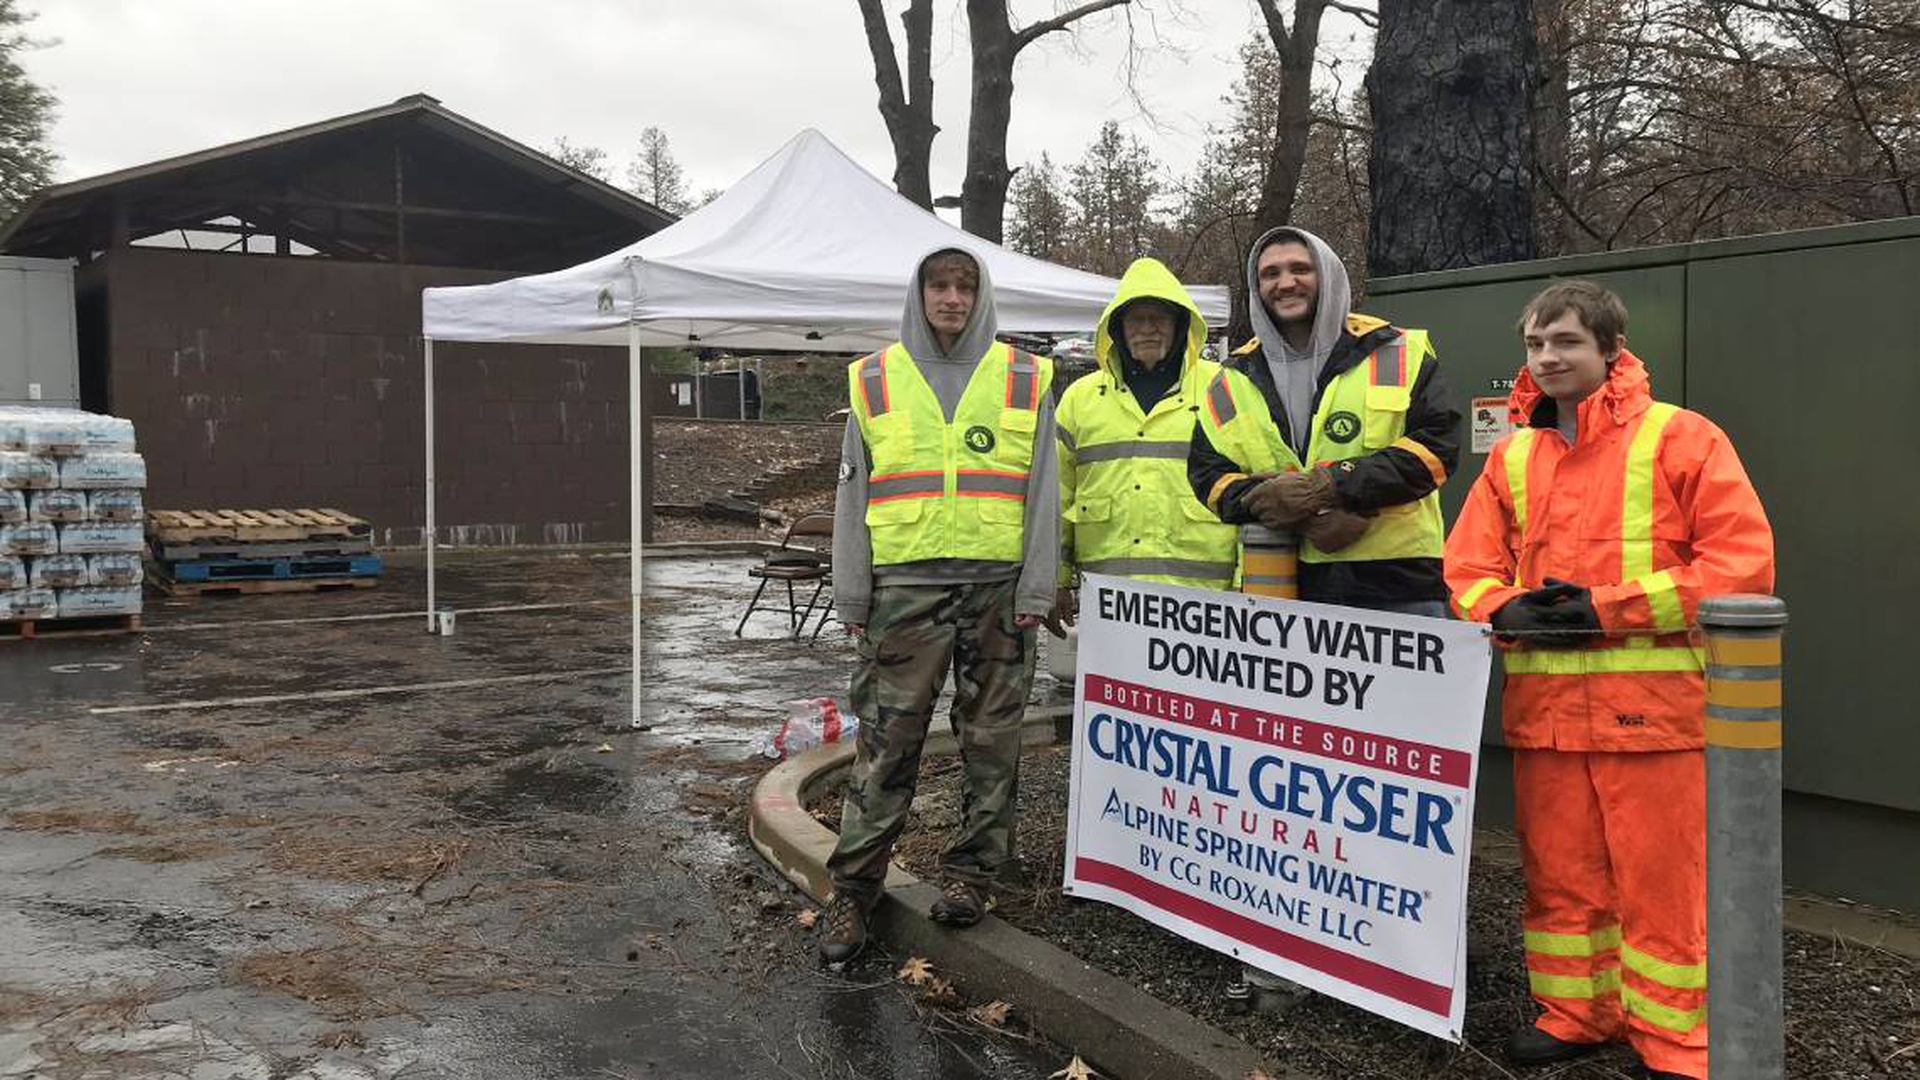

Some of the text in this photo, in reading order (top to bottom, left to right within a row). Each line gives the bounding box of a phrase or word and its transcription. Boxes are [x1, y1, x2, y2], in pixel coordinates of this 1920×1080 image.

[1098, 587, 1445, 674] EMERGENCY WATER
[1148, 637, 1375, 711] DONATED BY
[1088, 713, 1240, 798] CRYSTAL
[1104, 683, 1443, 776] BOTTLED AT THE SOURCE
[1101, 787, 1189, 847] ALPINE
[1195, 826, 1299, 885] SPRING
[1162, 786, 1348, 863] NATURAL
[1139, 844, 1373, 947] BY CG ROXANE LLC
